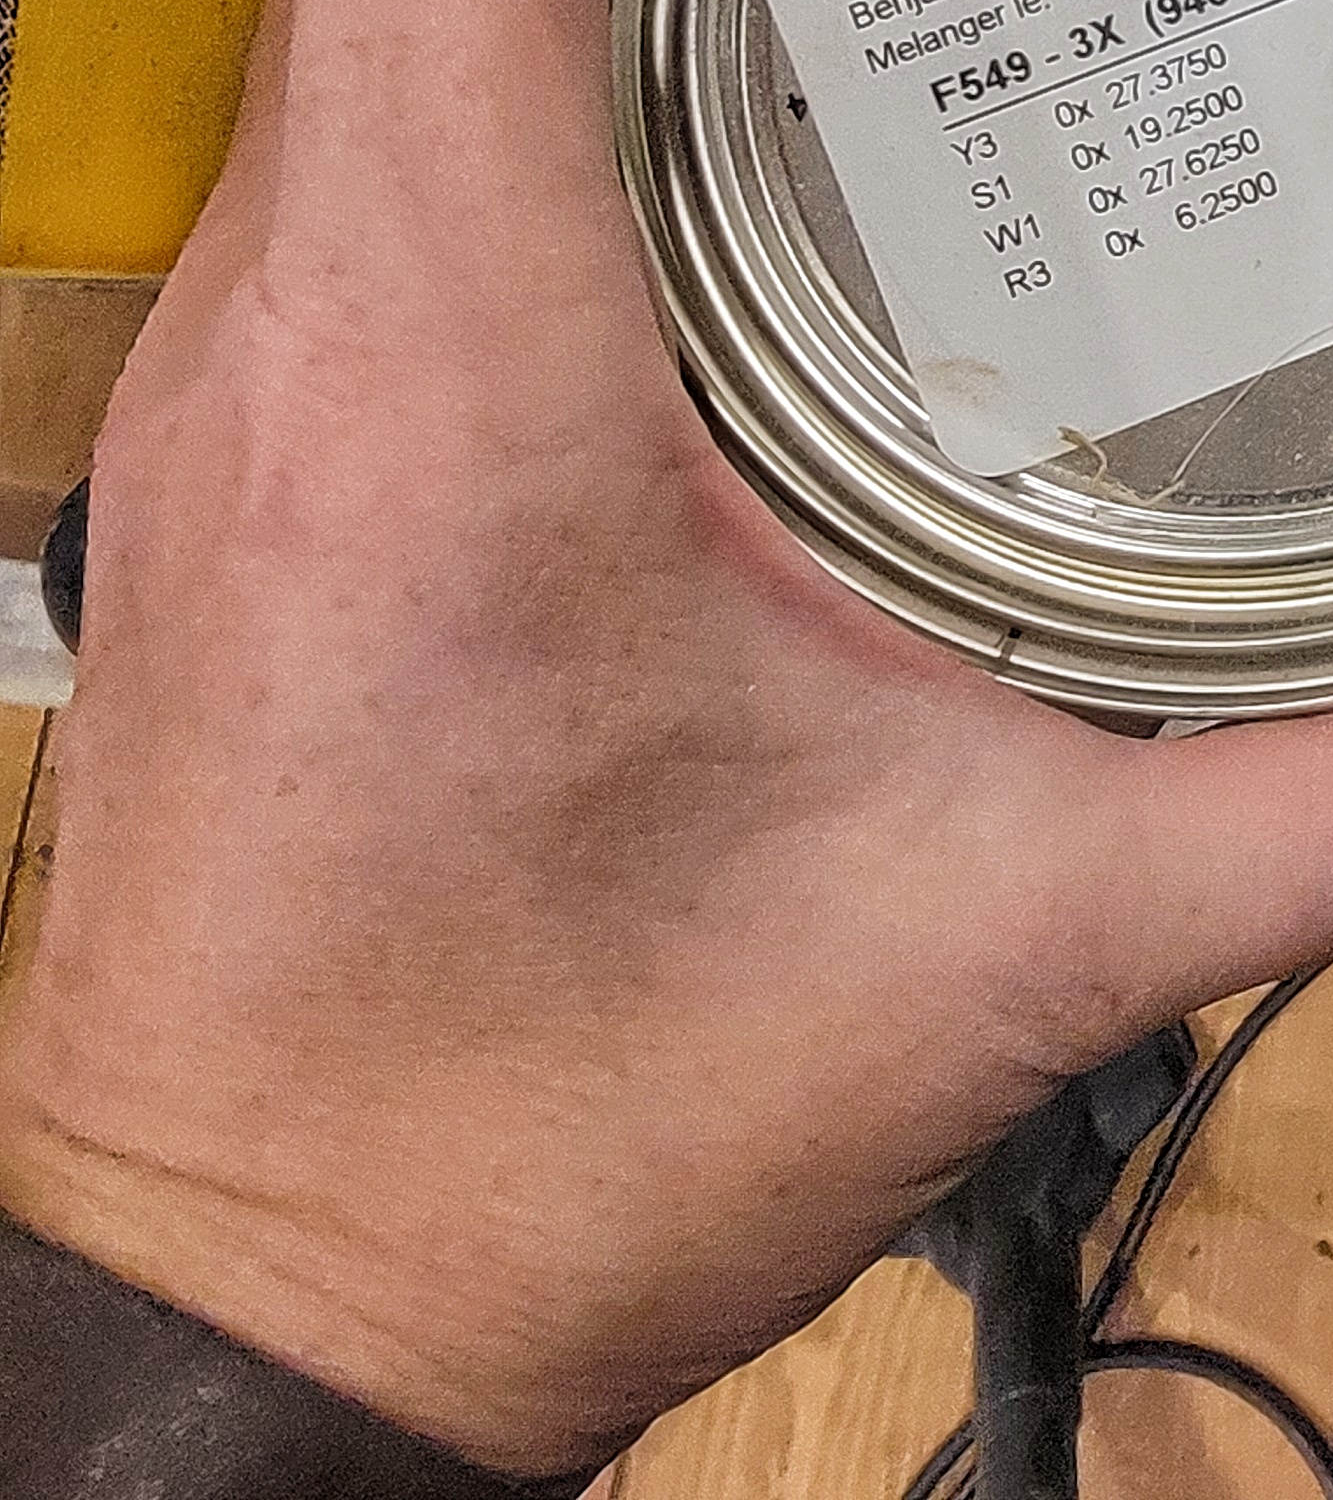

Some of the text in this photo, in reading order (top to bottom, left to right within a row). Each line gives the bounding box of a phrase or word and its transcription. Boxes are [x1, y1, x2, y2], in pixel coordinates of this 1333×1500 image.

[864, 4, 1005, 75] Melanger
[929, 51, 1032, 114] F549
[1068, 13, 1126, 59] 3X
[949, 43, 1227, 166] Y3 0x 27.3750
[970, 85, 1243, 209] S1 0x 19.2500
[983, 128, 1260, 253] W1 0x 27.6250
[1003, 171, 1278, 299] R3 0x 6.2500
